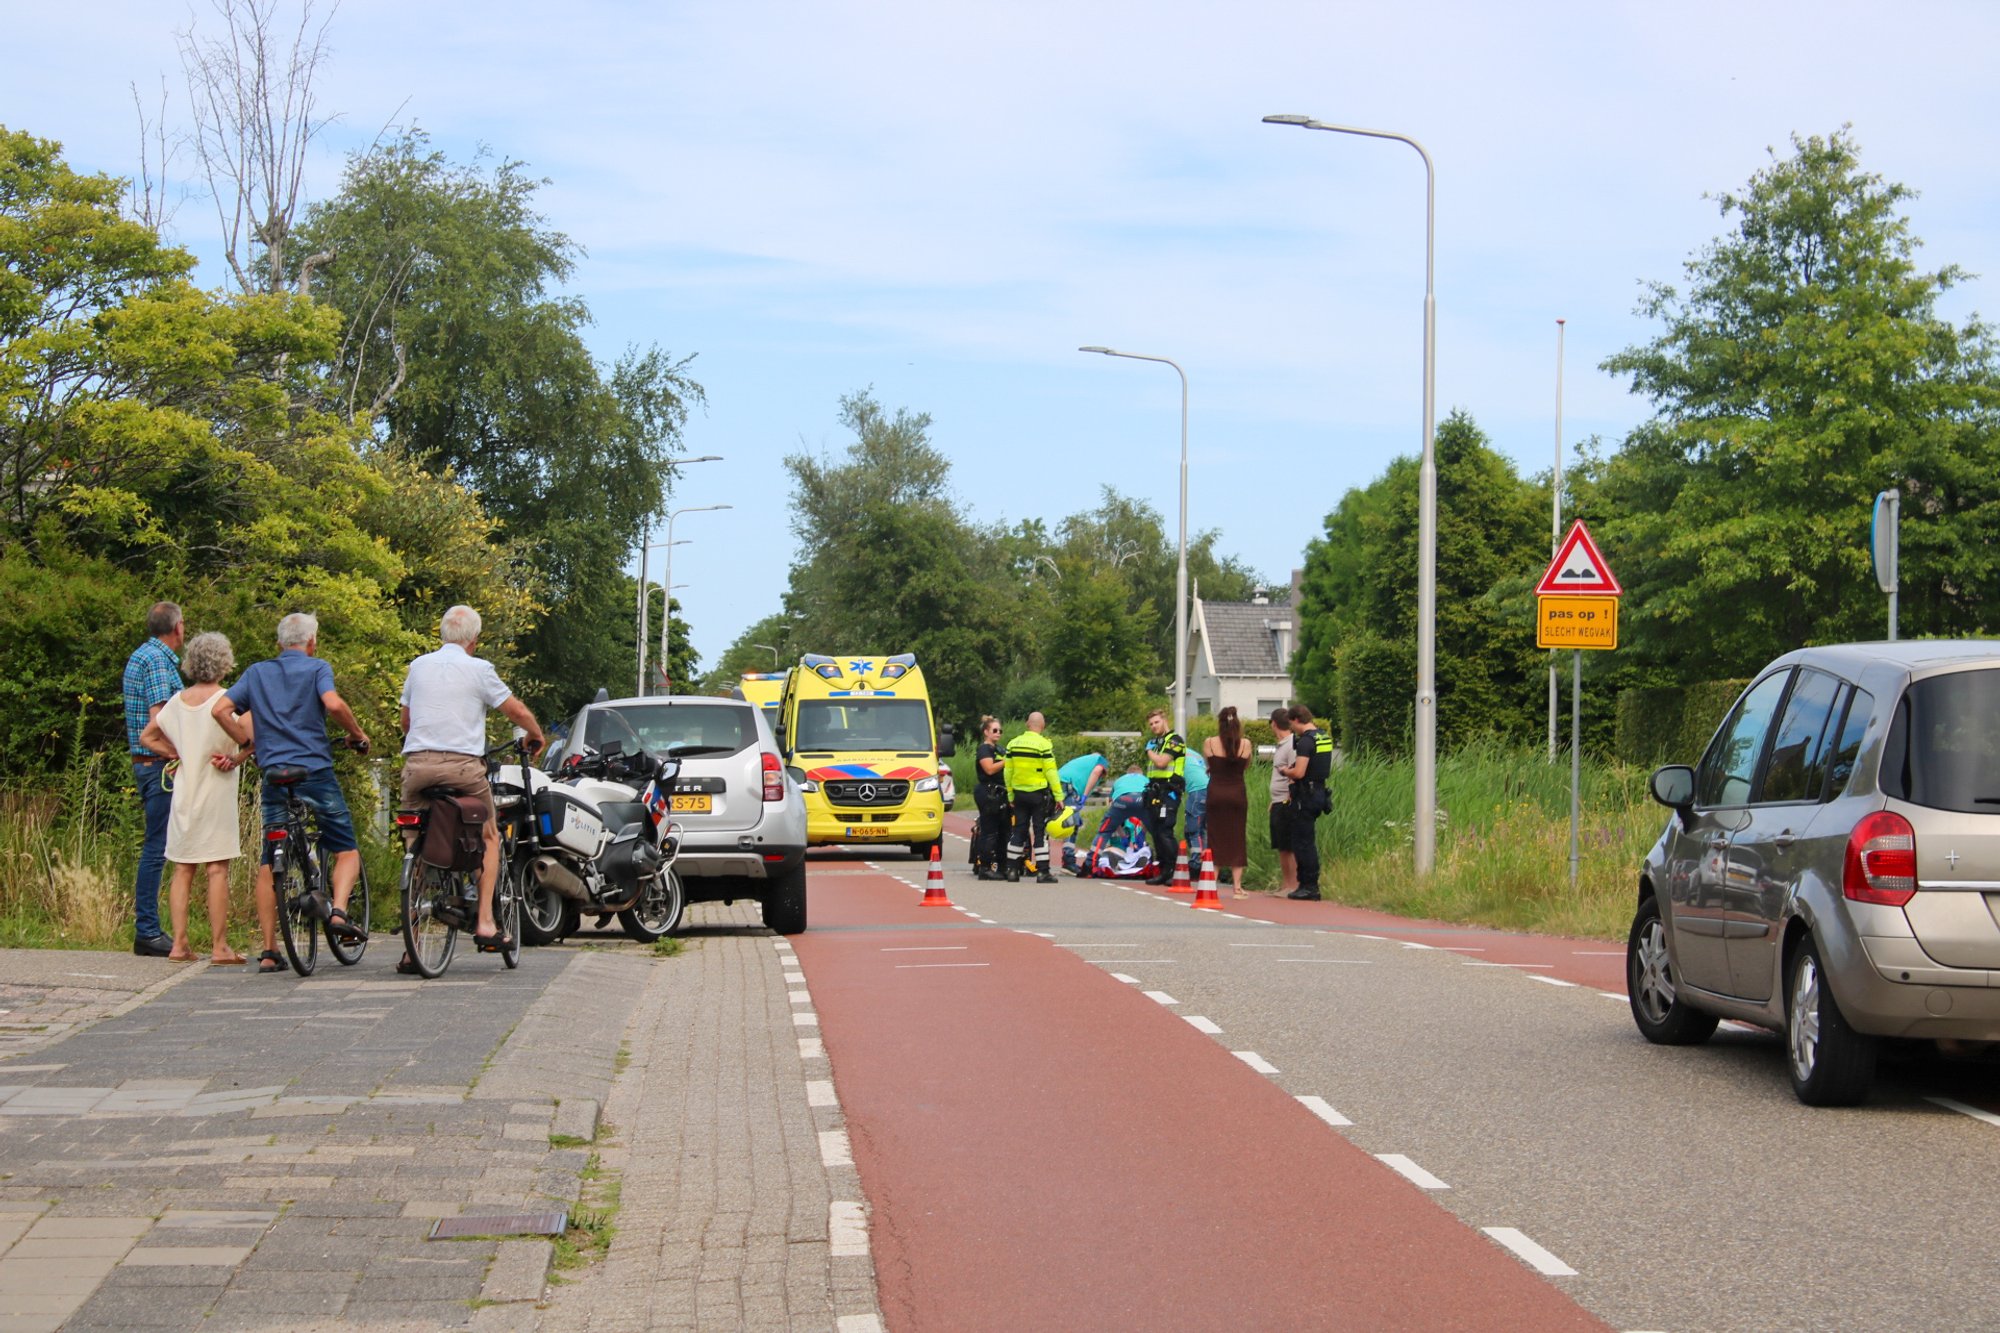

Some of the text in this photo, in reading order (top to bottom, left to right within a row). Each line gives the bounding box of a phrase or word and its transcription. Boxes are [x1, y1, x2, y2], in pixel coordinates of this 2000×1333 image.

[1549, 609, 1608, 620] pas op !
[1545, 626, 1610, 637] SLECHT WEGVAK
[570, 817, 597, 836] POLITIE
